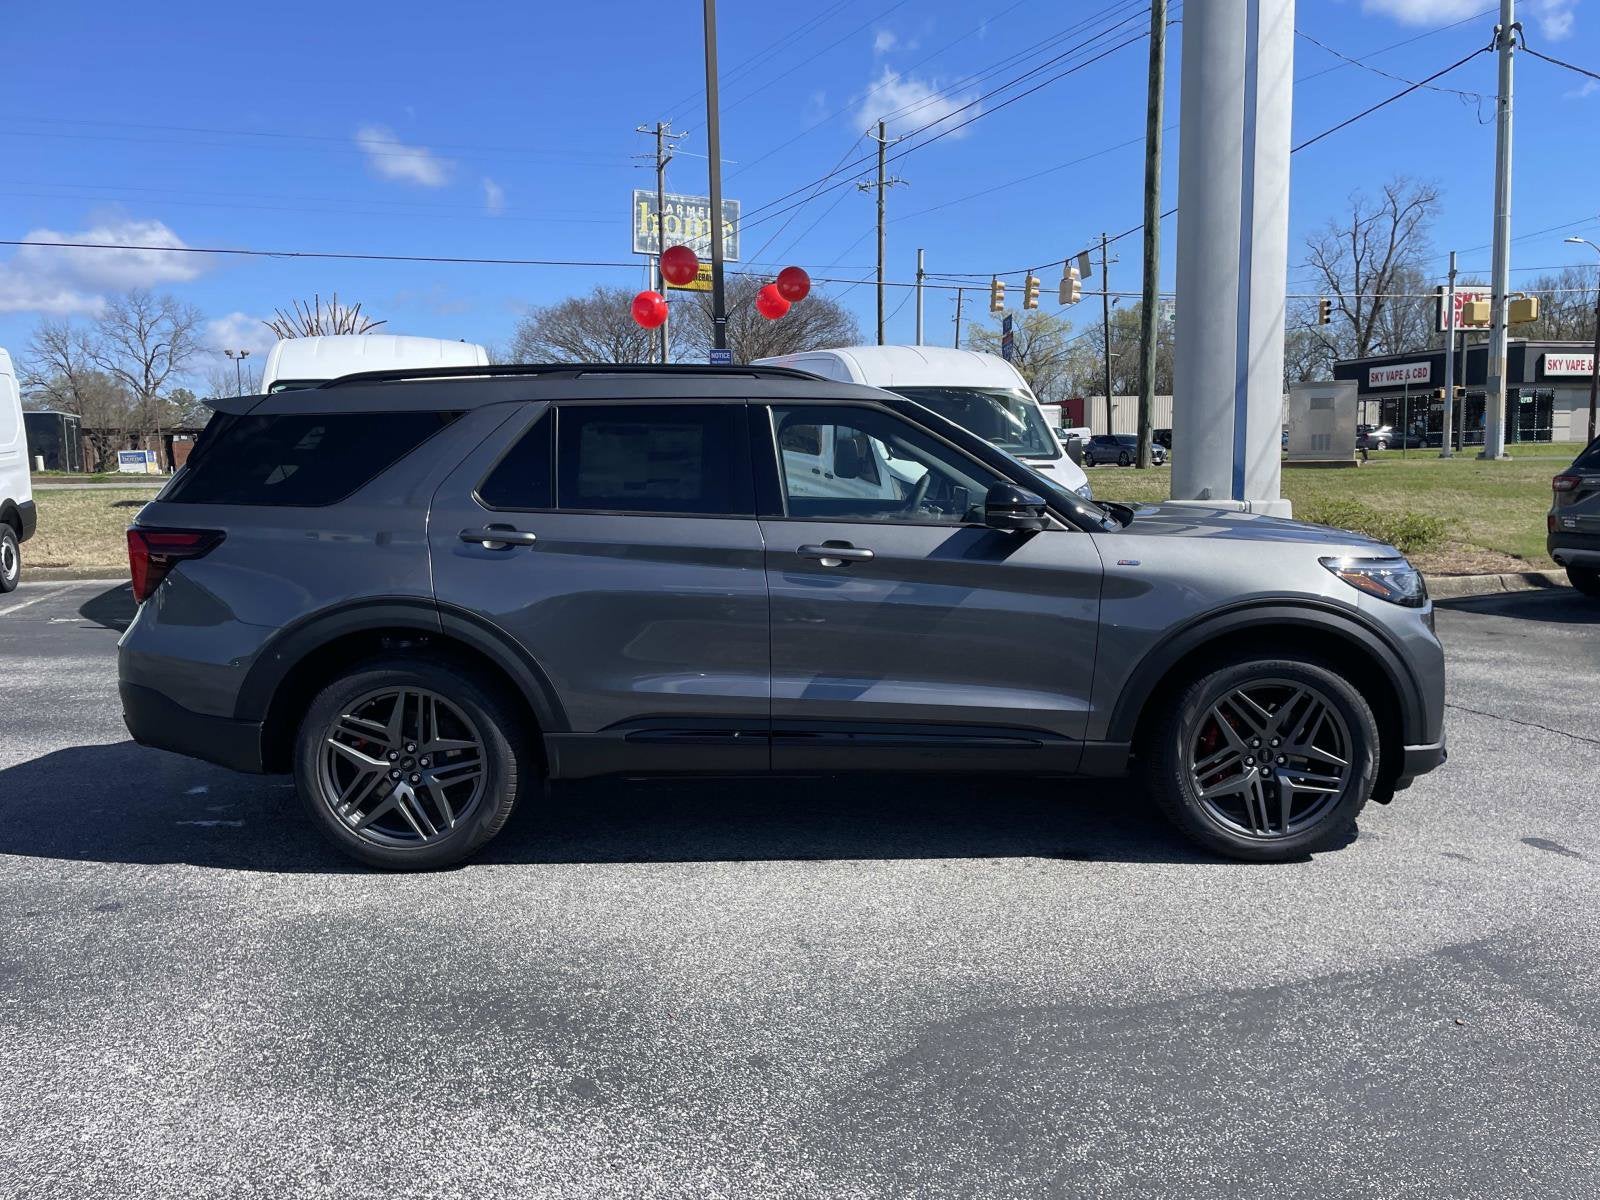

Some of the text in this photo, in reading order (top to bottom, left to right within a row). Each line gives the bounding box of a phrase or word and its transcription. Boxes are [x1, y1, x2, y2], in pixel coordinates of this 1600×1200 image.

[1547, 359, 1563, 370] SKY
[1566, 359, 1585, 370] VAPE
[1370, 372, 1384, 382] SKY
[1386, 370, 1404, 381] VAPE
[1412, 367, 1428, 379] CBD
